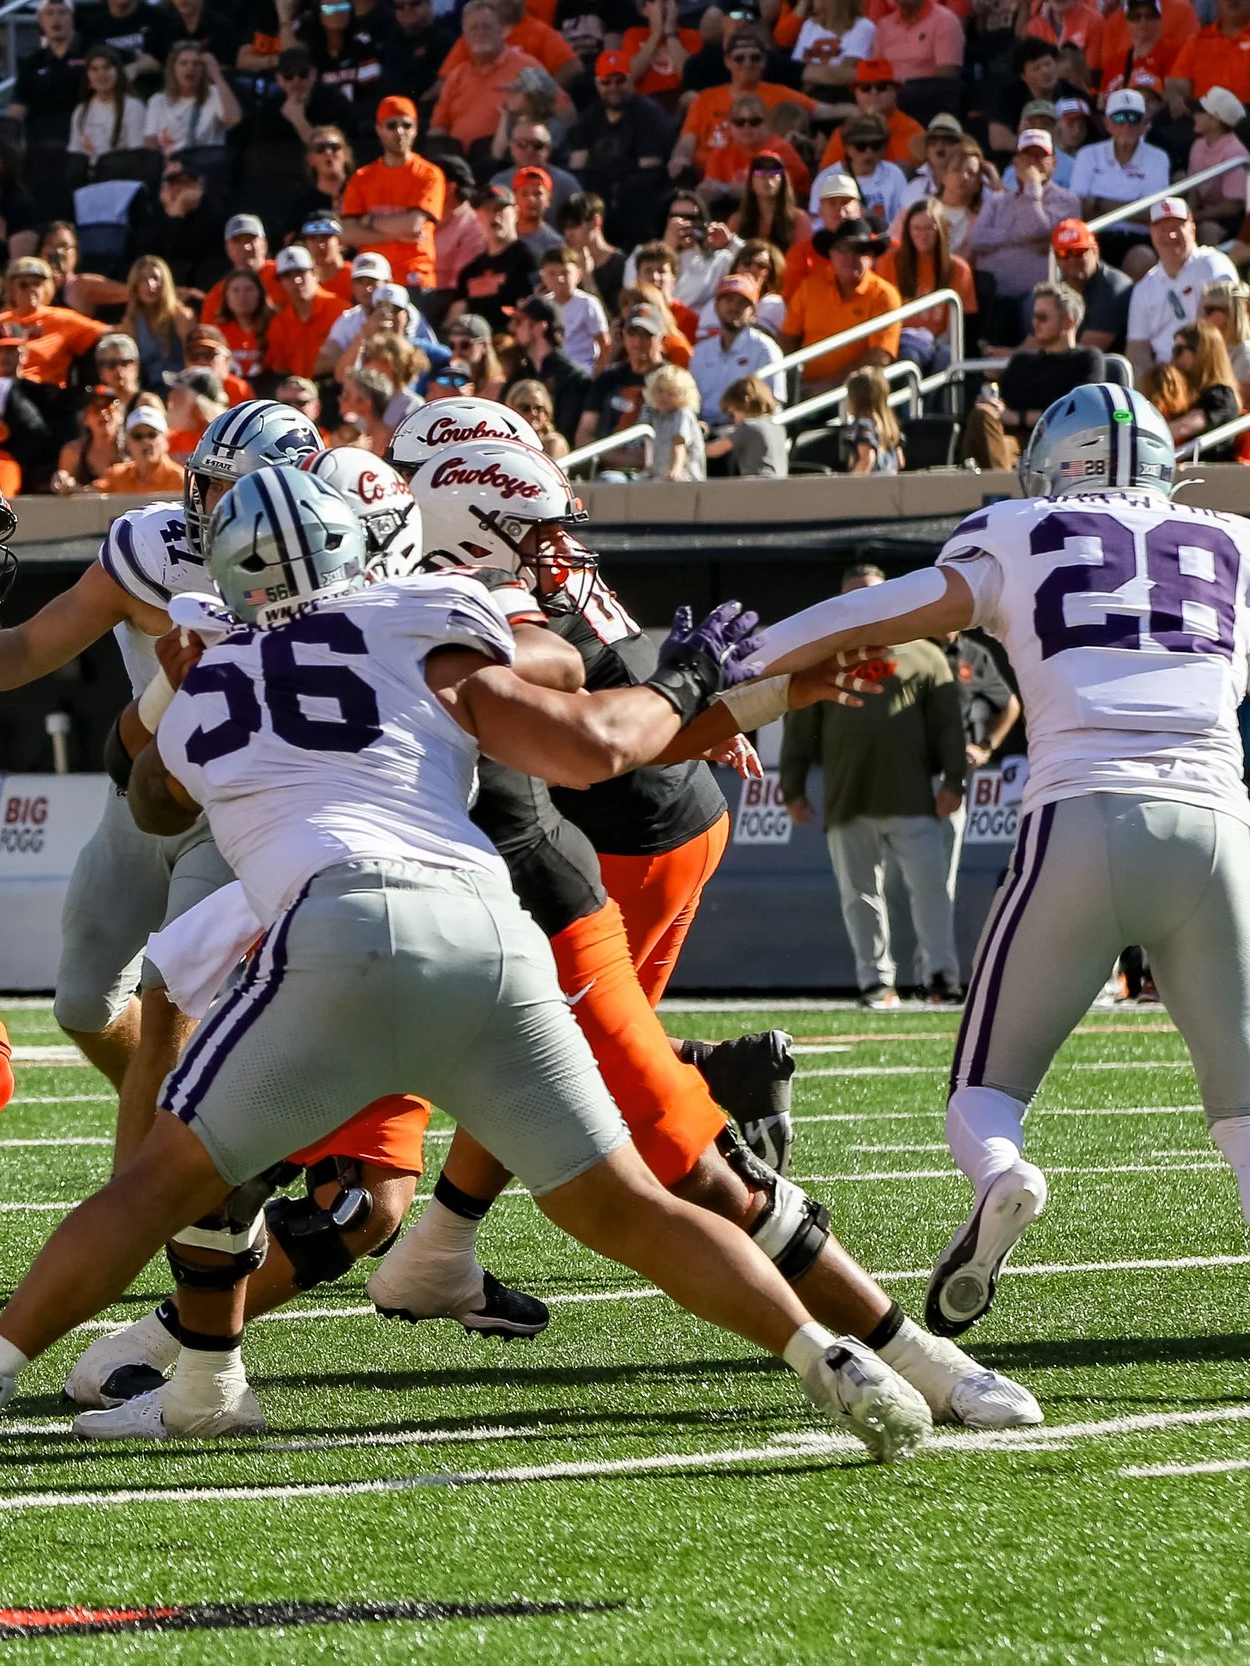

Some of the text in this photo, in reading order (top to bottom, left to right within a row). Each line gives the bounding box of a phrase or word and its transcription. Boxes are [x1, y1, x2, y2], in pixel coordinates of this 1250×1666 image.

[205, 458, 234, 472] K-STATE
[430, 457, 542, 499] Cowboys
[1084, 460, 1105, 475] 28
[265, 583, 289, 603] 56
[1030, 512, 1240, 664] 28
[180, 613, 384, 768] 56
[976, 780, 1000, 806] BI
[5, 797, 48, 825] BIG
[739, 811, 788, 837] FOGG
[969, 811, 1017, 837] FOGG
